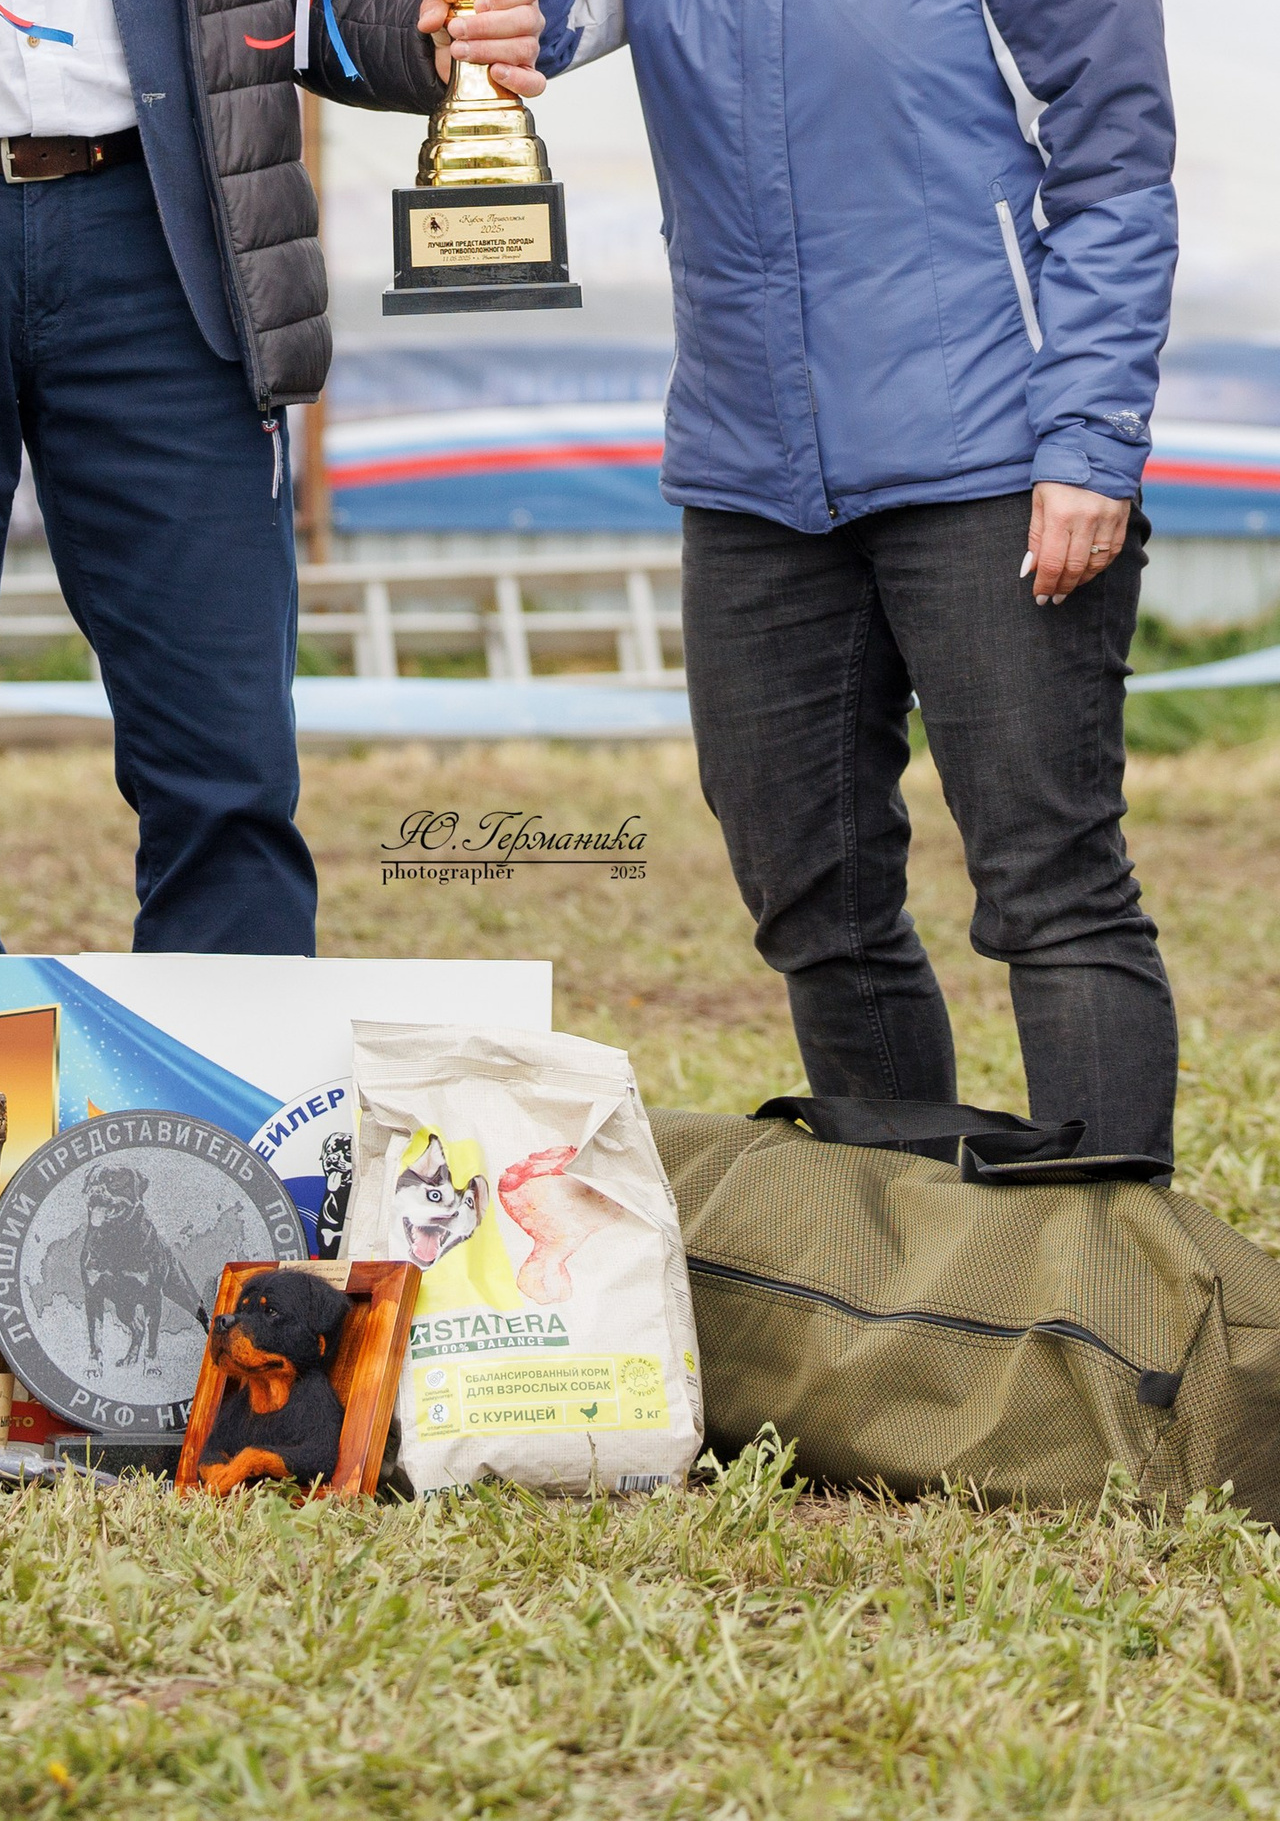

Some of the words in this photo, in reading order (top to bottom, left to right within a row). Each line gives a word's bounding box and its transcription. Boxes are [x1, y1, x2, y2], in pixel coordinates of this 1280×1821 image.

[428, 240, 454, 249] ЛУЧШИЙ
[455, 238, 507, 248] ПРЕДСТАВИТЕЛЬ
[508, 237, 535, 246] ПОРОДЫ
[440, 246, 505, 255] ПРОТИВОПОЛОЖНОГО
[506, 245, 523, 253] ПОЛА
[37, 1119, 256, 1183] ПРЕДСТАВИТЕЛЬ
[434, 1313, 567, 1341] STATERA
[433, 1342, 470, 1355] 100%
[477, 1336, 546, 1350] BALANCE
[465, 1367, 579, 1384] СБАЛАНСИРОВАННЫЙ
[581, 1367, 610, 1377] КОРМ
[466, 1386, 494, 1399] ДЛЯ
[497, 1382, 569, 1395] ВЗРОСЛЫХ
[570, 1380, 612, 1391] СОБАК
[483, 1406, 556, 1424] КУРИЦЕЙ
[634, 1407, 643, 1420] 3
[647, 1409, 661, 1419] кг
